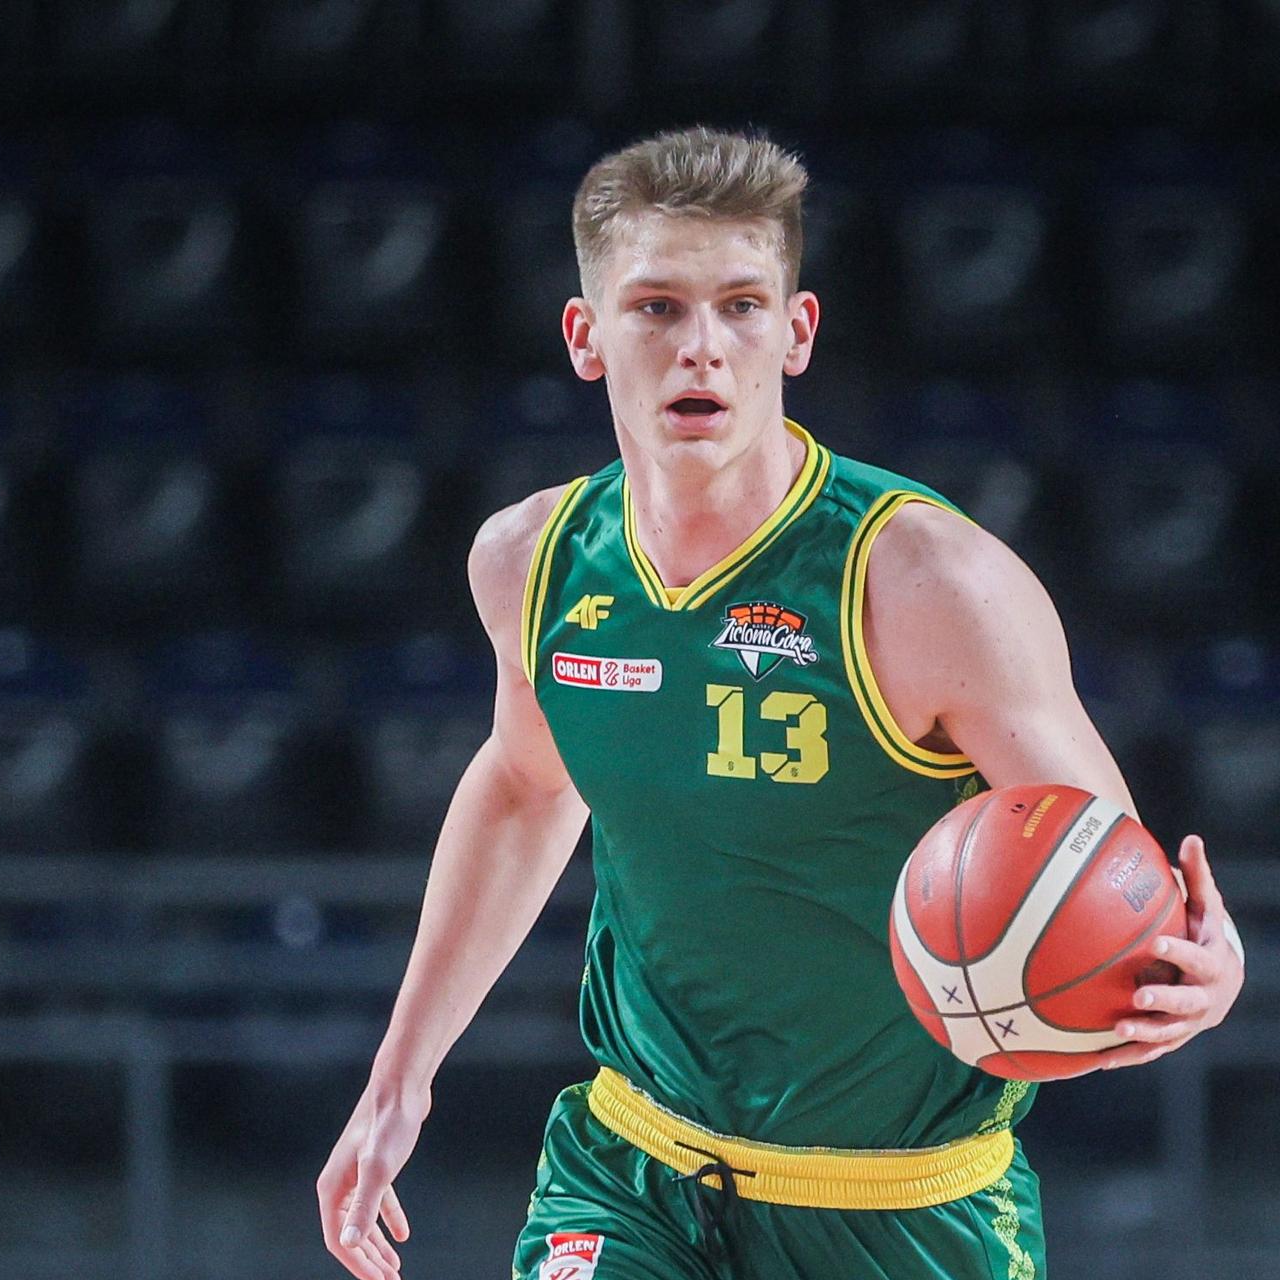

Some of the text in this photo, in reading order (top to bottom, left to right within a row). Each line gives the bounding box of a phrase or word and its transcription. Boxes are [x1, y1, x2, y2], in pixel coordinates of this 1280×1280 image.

[557, 660, 598, 681] ORLEN
[623, 663, 656, 674] Basket
[622, 676, 642, 688] Liga
[706, 683, 830, 784] 13
[554, 1240, 596, 1256] ORLEN
